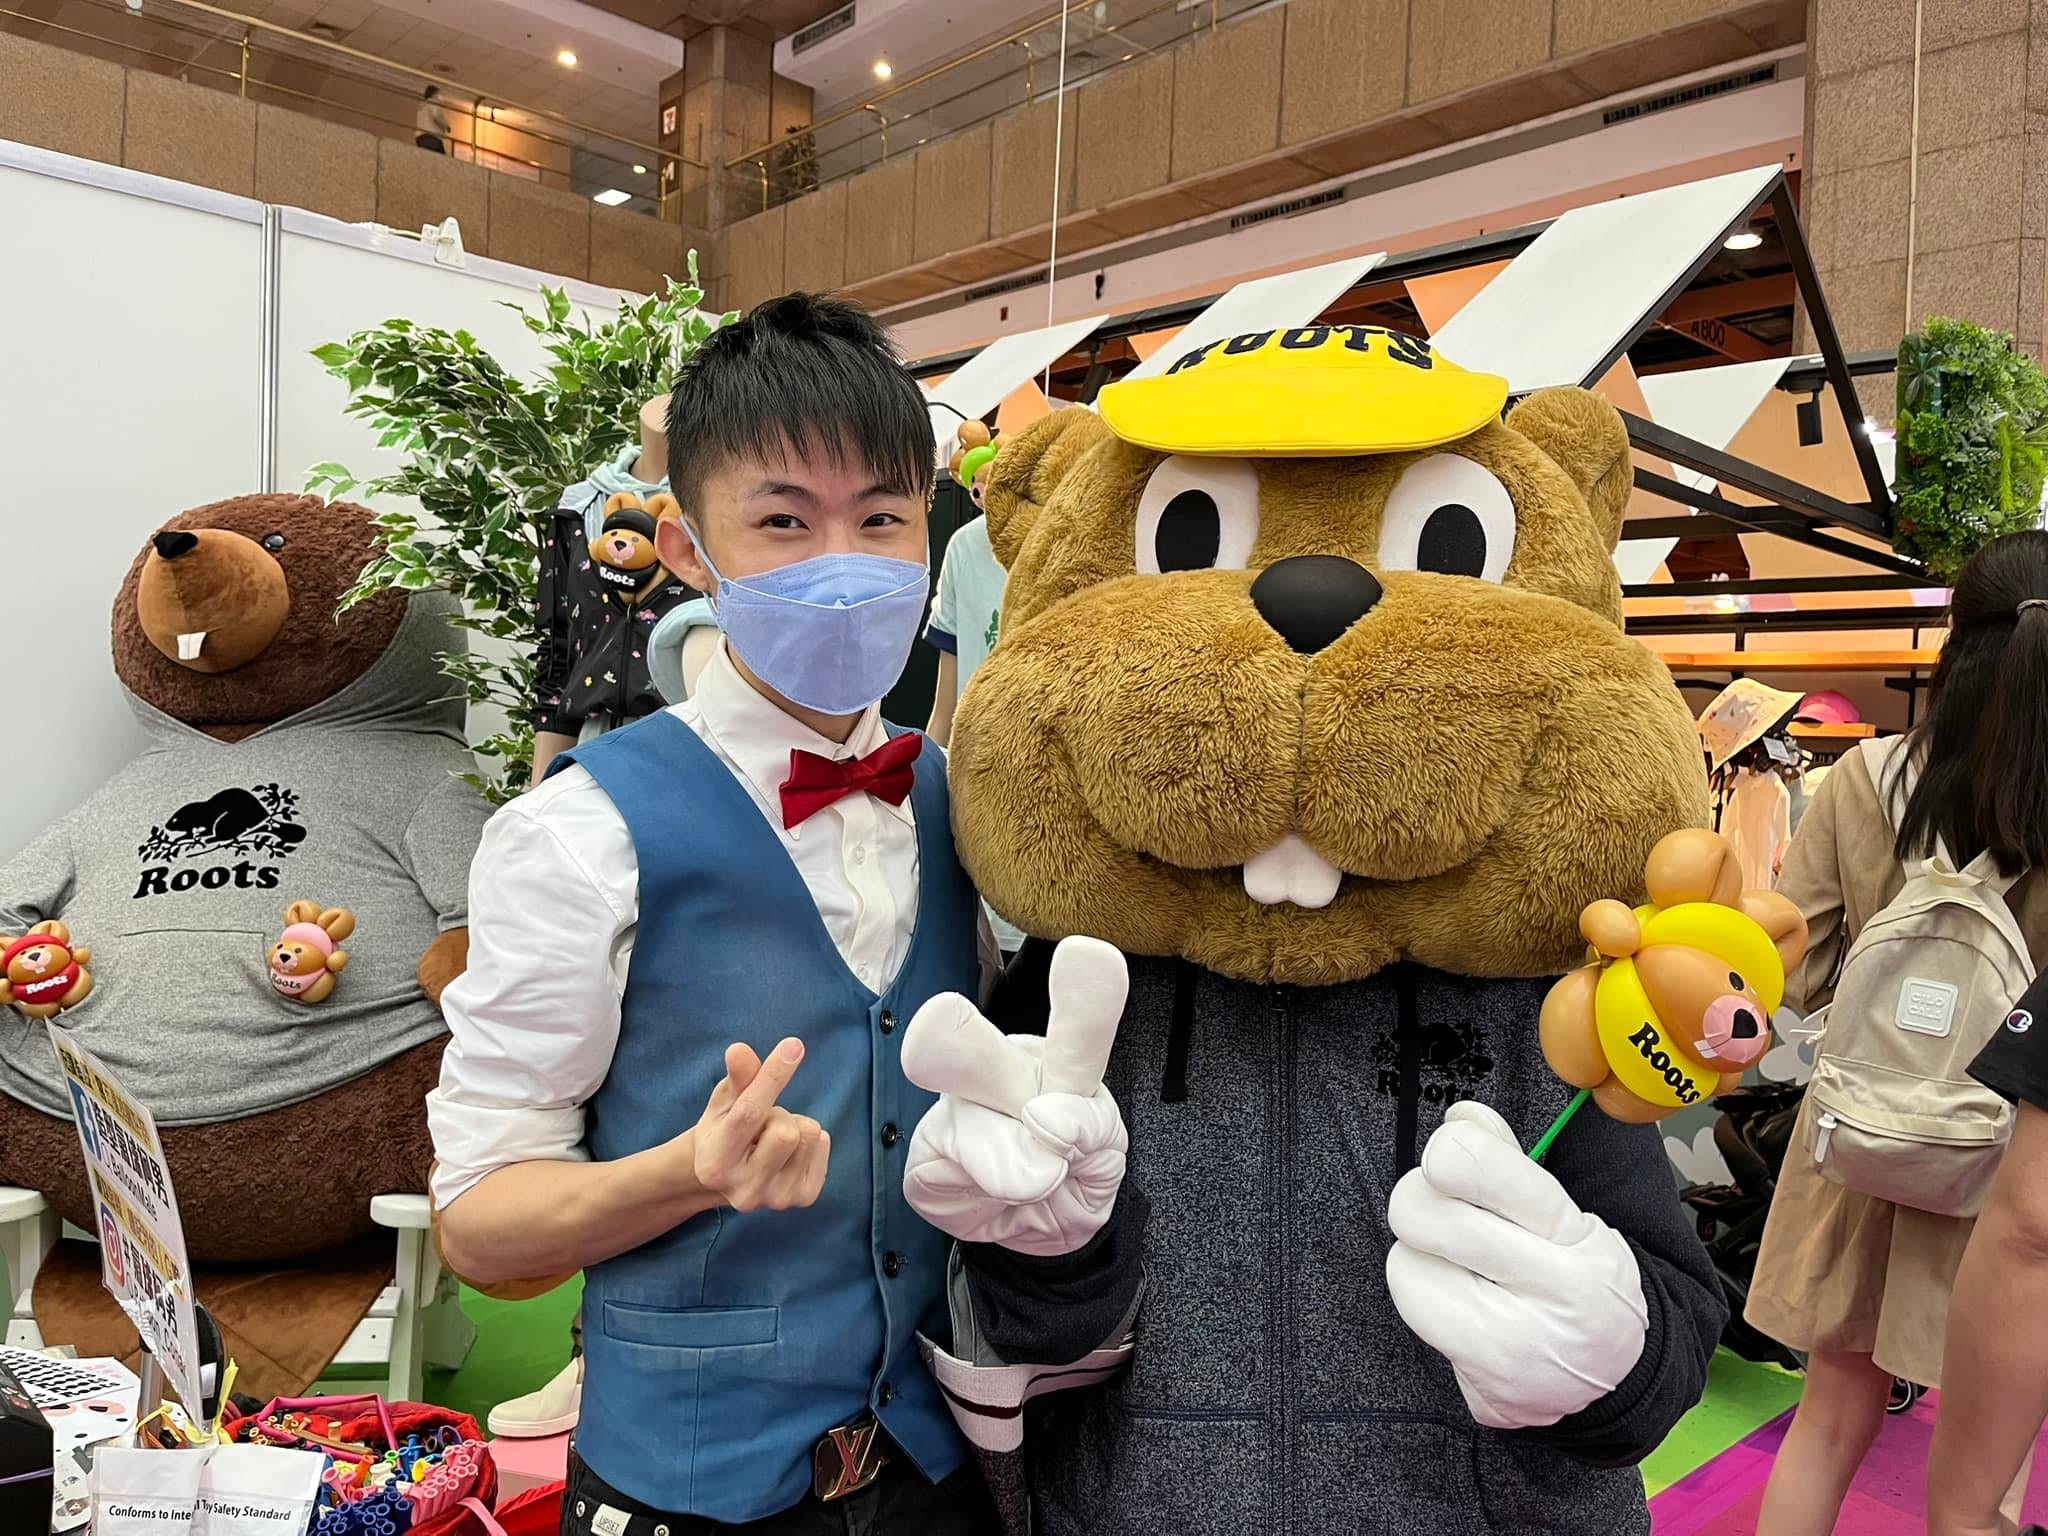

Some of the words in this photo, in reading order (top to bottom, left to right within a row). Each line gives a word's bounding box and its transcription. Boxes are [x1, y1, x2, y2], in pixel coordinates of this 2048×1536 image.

[1166, 326, 1433, 376] ROOTS
[599, 567, 636, 587] Roots
[133, 860, 281, 899] Roots
[25, 975, 69, 995] Roots
[1628, 1021, 1701, 1104] Roots
[1375, 1069, 1478, 1106] Rots
[108, 1505, 156, 1519] Conforms
[158, 1508, 168, 1520] to
[213, 1502, 241, 1518] Safety
[242, 1505, 291, 1521] Standard
